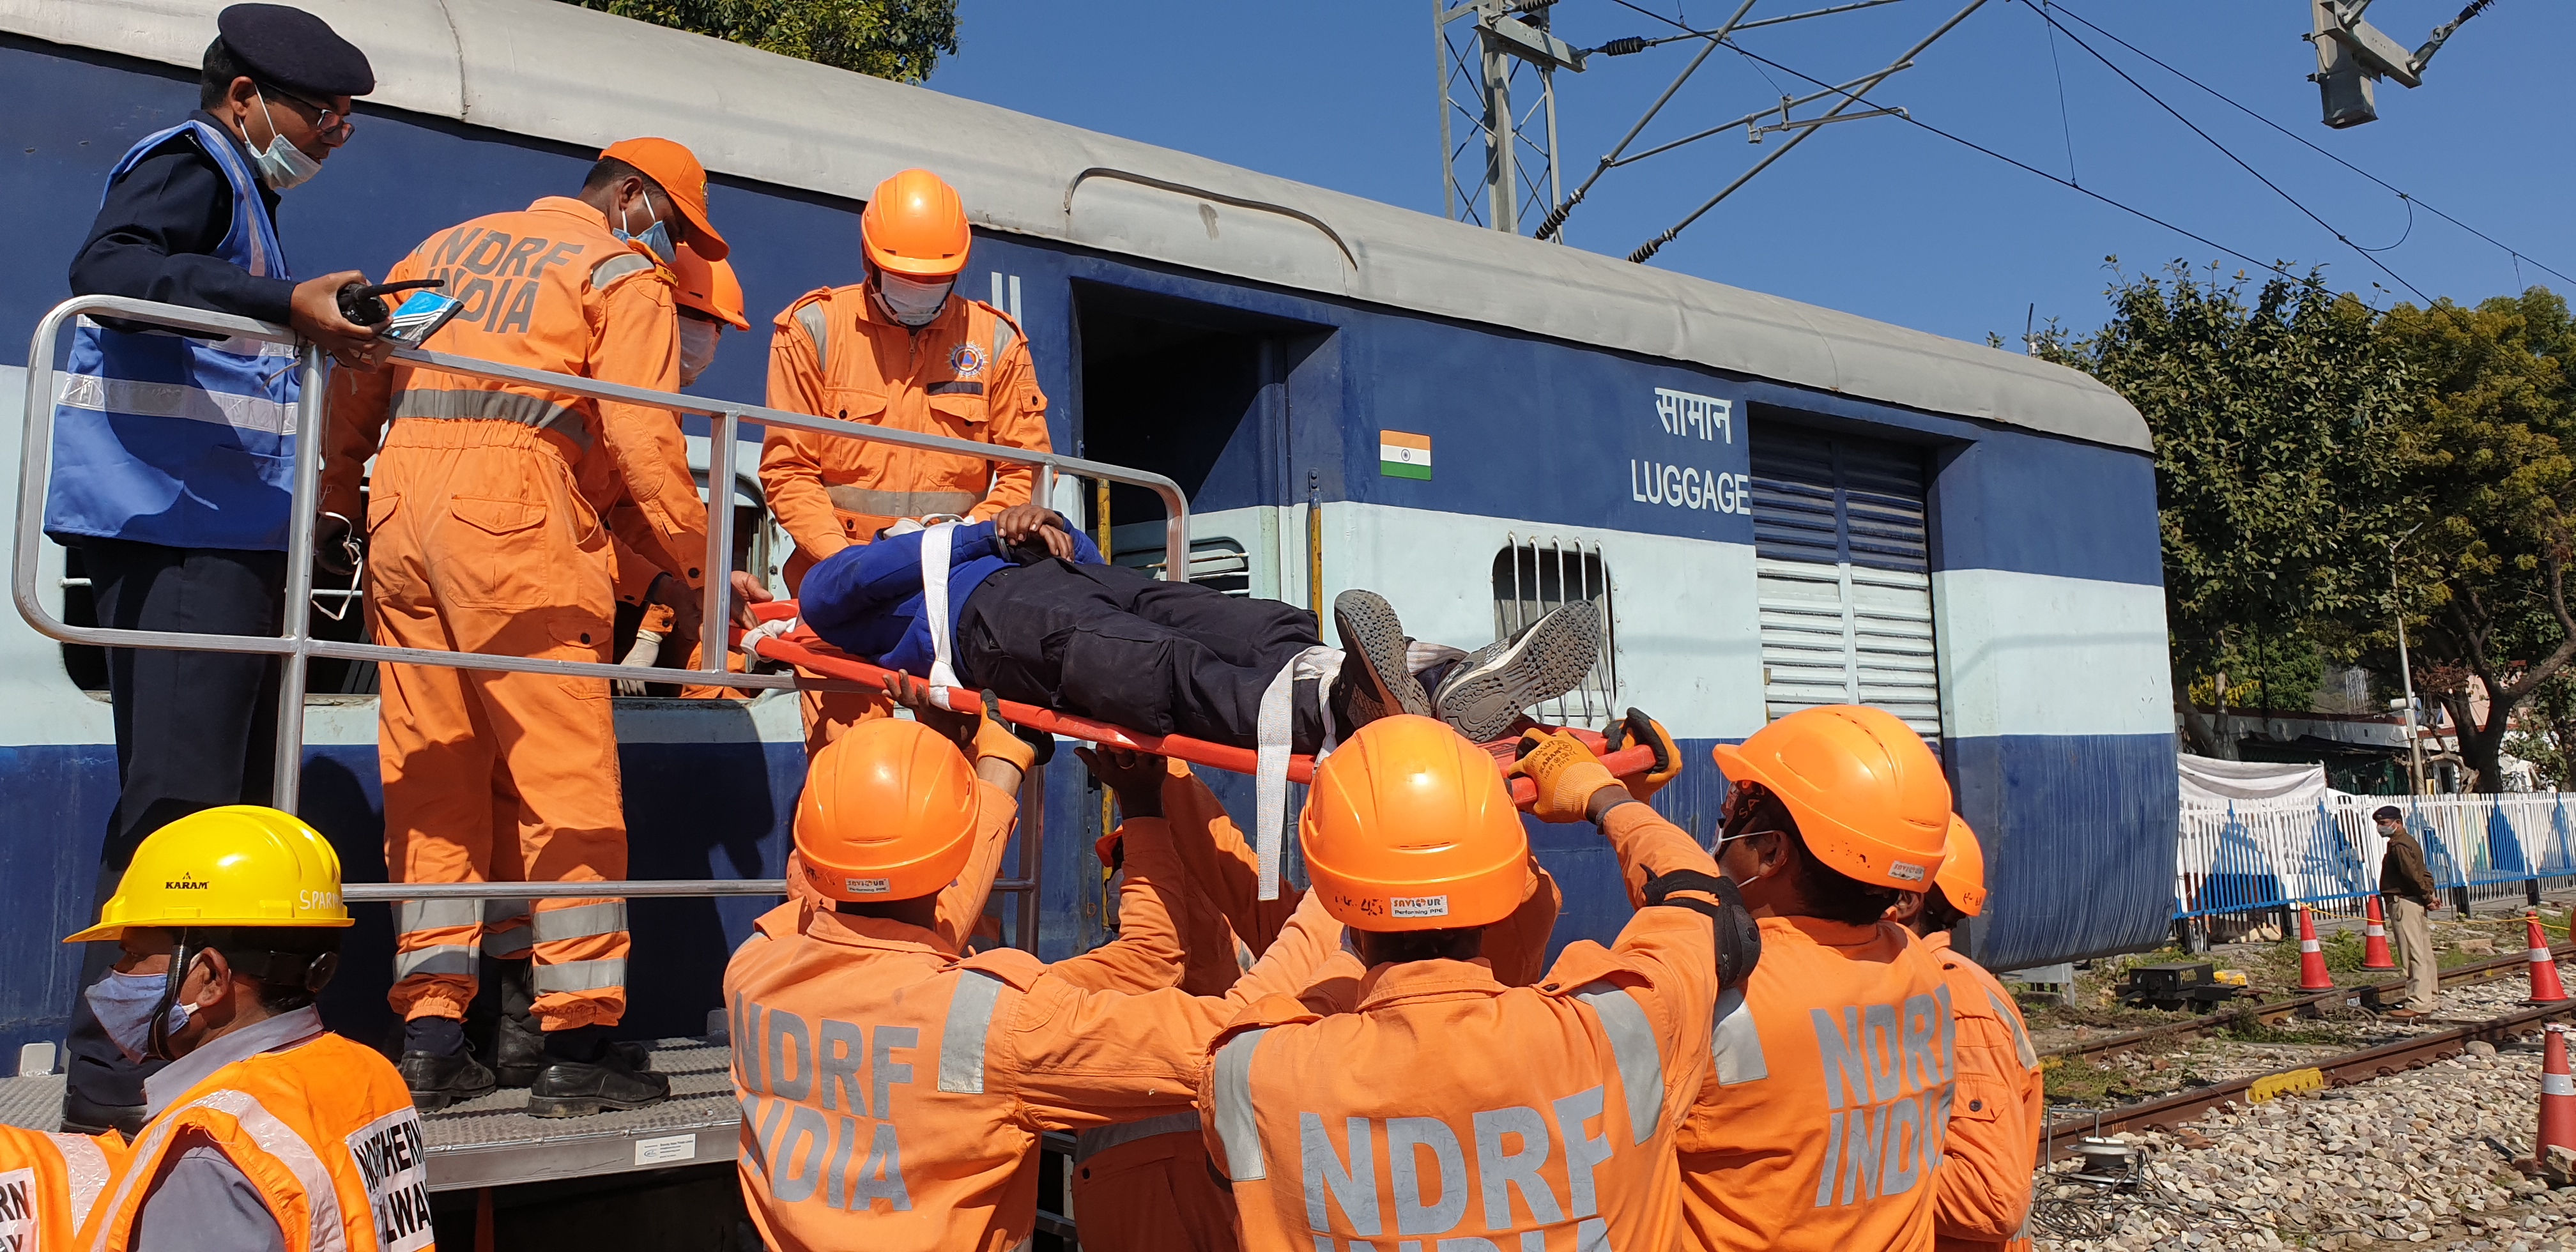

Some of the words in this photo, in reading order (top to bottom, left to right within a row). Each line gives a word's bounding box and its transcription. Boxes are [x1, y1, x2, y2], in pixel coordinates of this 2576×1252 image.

[431, 226, 585, 279] NDRF
[1654, 387, 1732, 444] सामान
[1631, 459, 1751, 515] LUGGAGE
[165, 881, 209, 889] KARAM
[1393, 897, 1441, 908] SAVIOUR
[733, 990, 919, 1121] NDRF
[1809, 981, 1956, 1110] NDRF
[1300, 1083, 1613, 1236] NDRF
